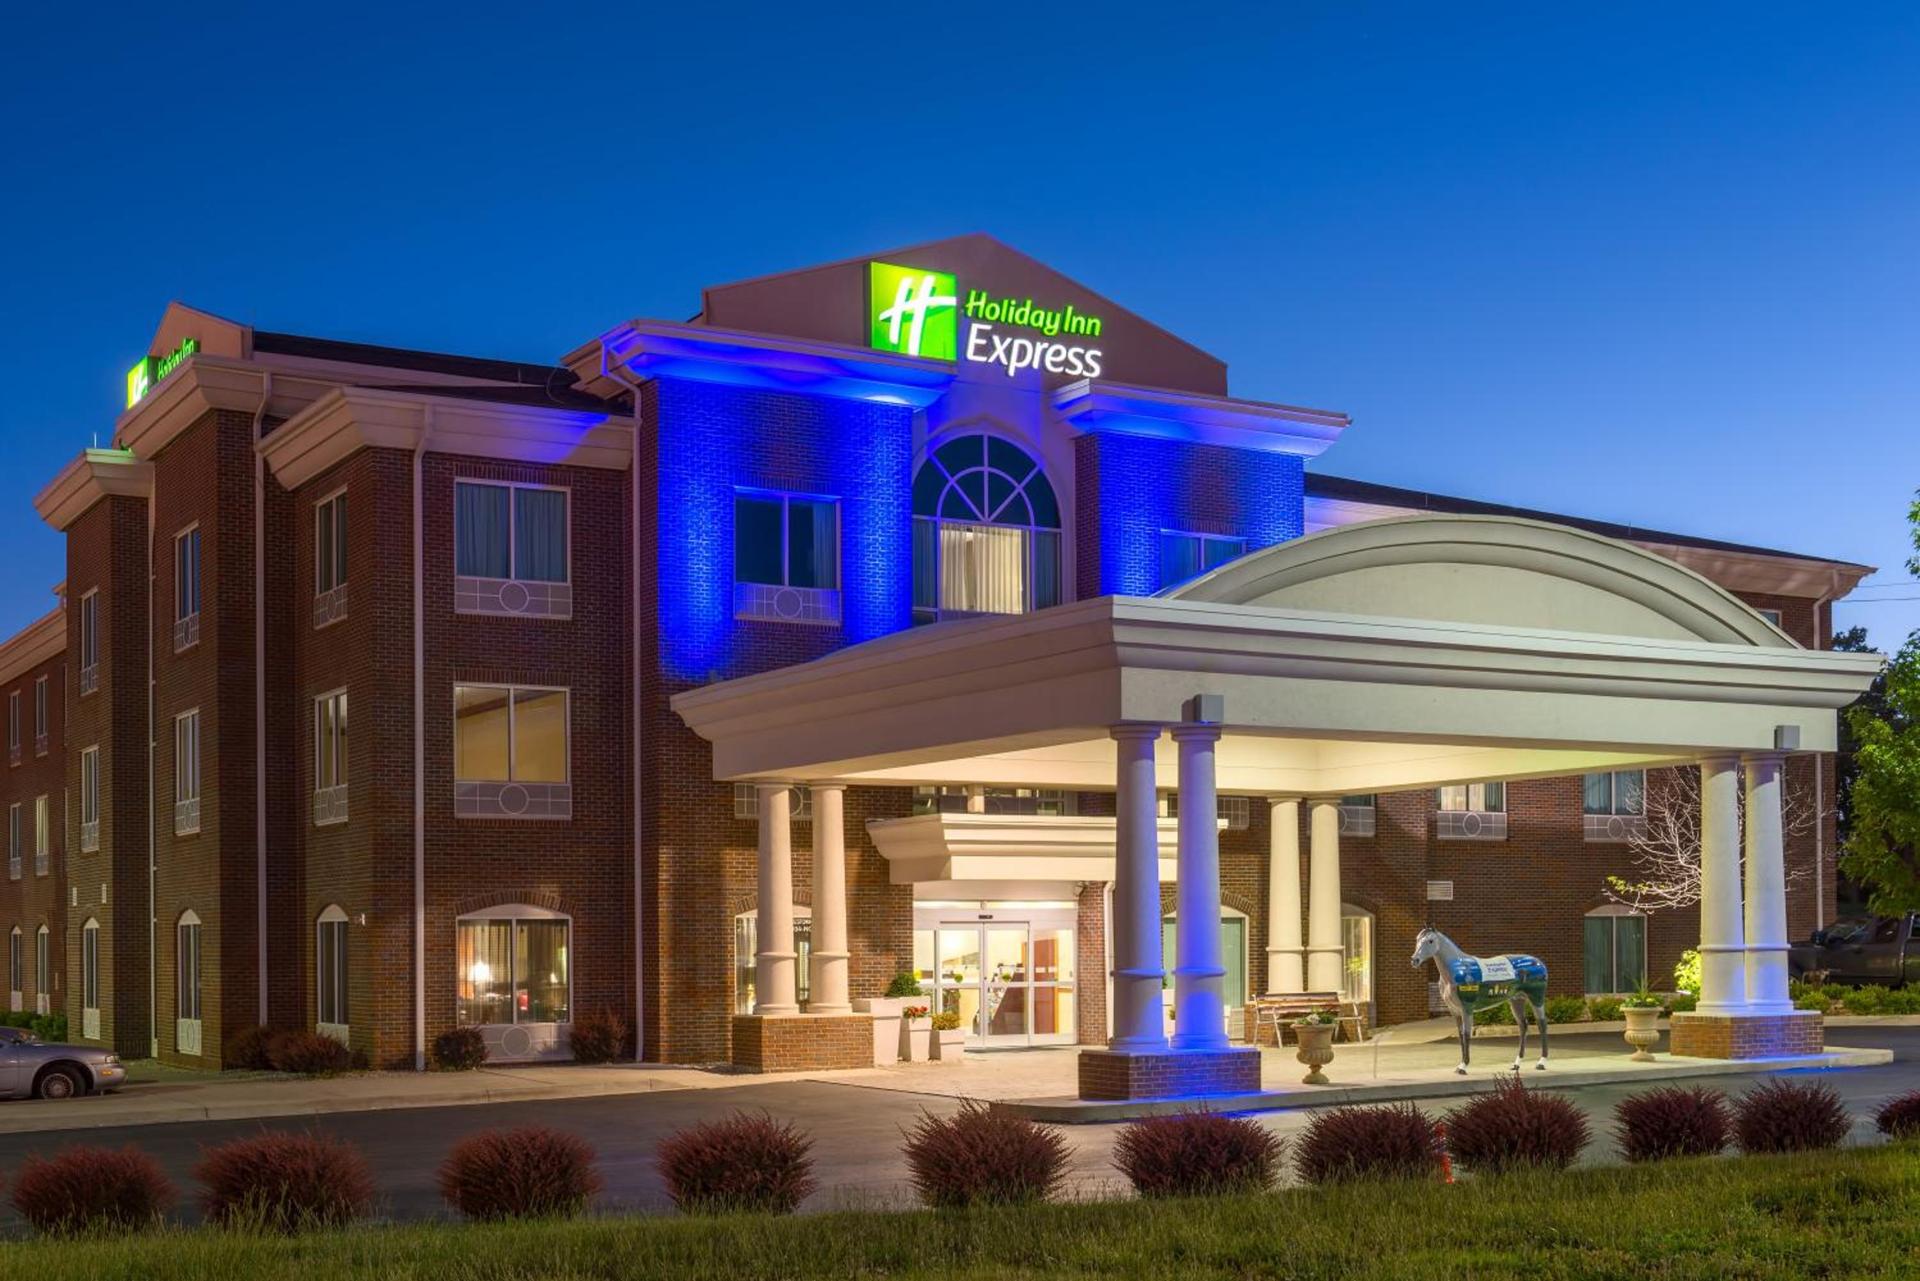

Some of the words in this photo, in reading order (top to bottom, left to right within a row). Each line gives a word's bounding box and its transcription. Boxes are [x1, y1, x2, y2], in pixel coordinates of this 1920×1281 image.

[879, 275, 957, 357] H
[966, 289, 1061, 336] Holiday
[1063, 304, 1101, 336] Inn
[966, 322, 1102, 378] Express
